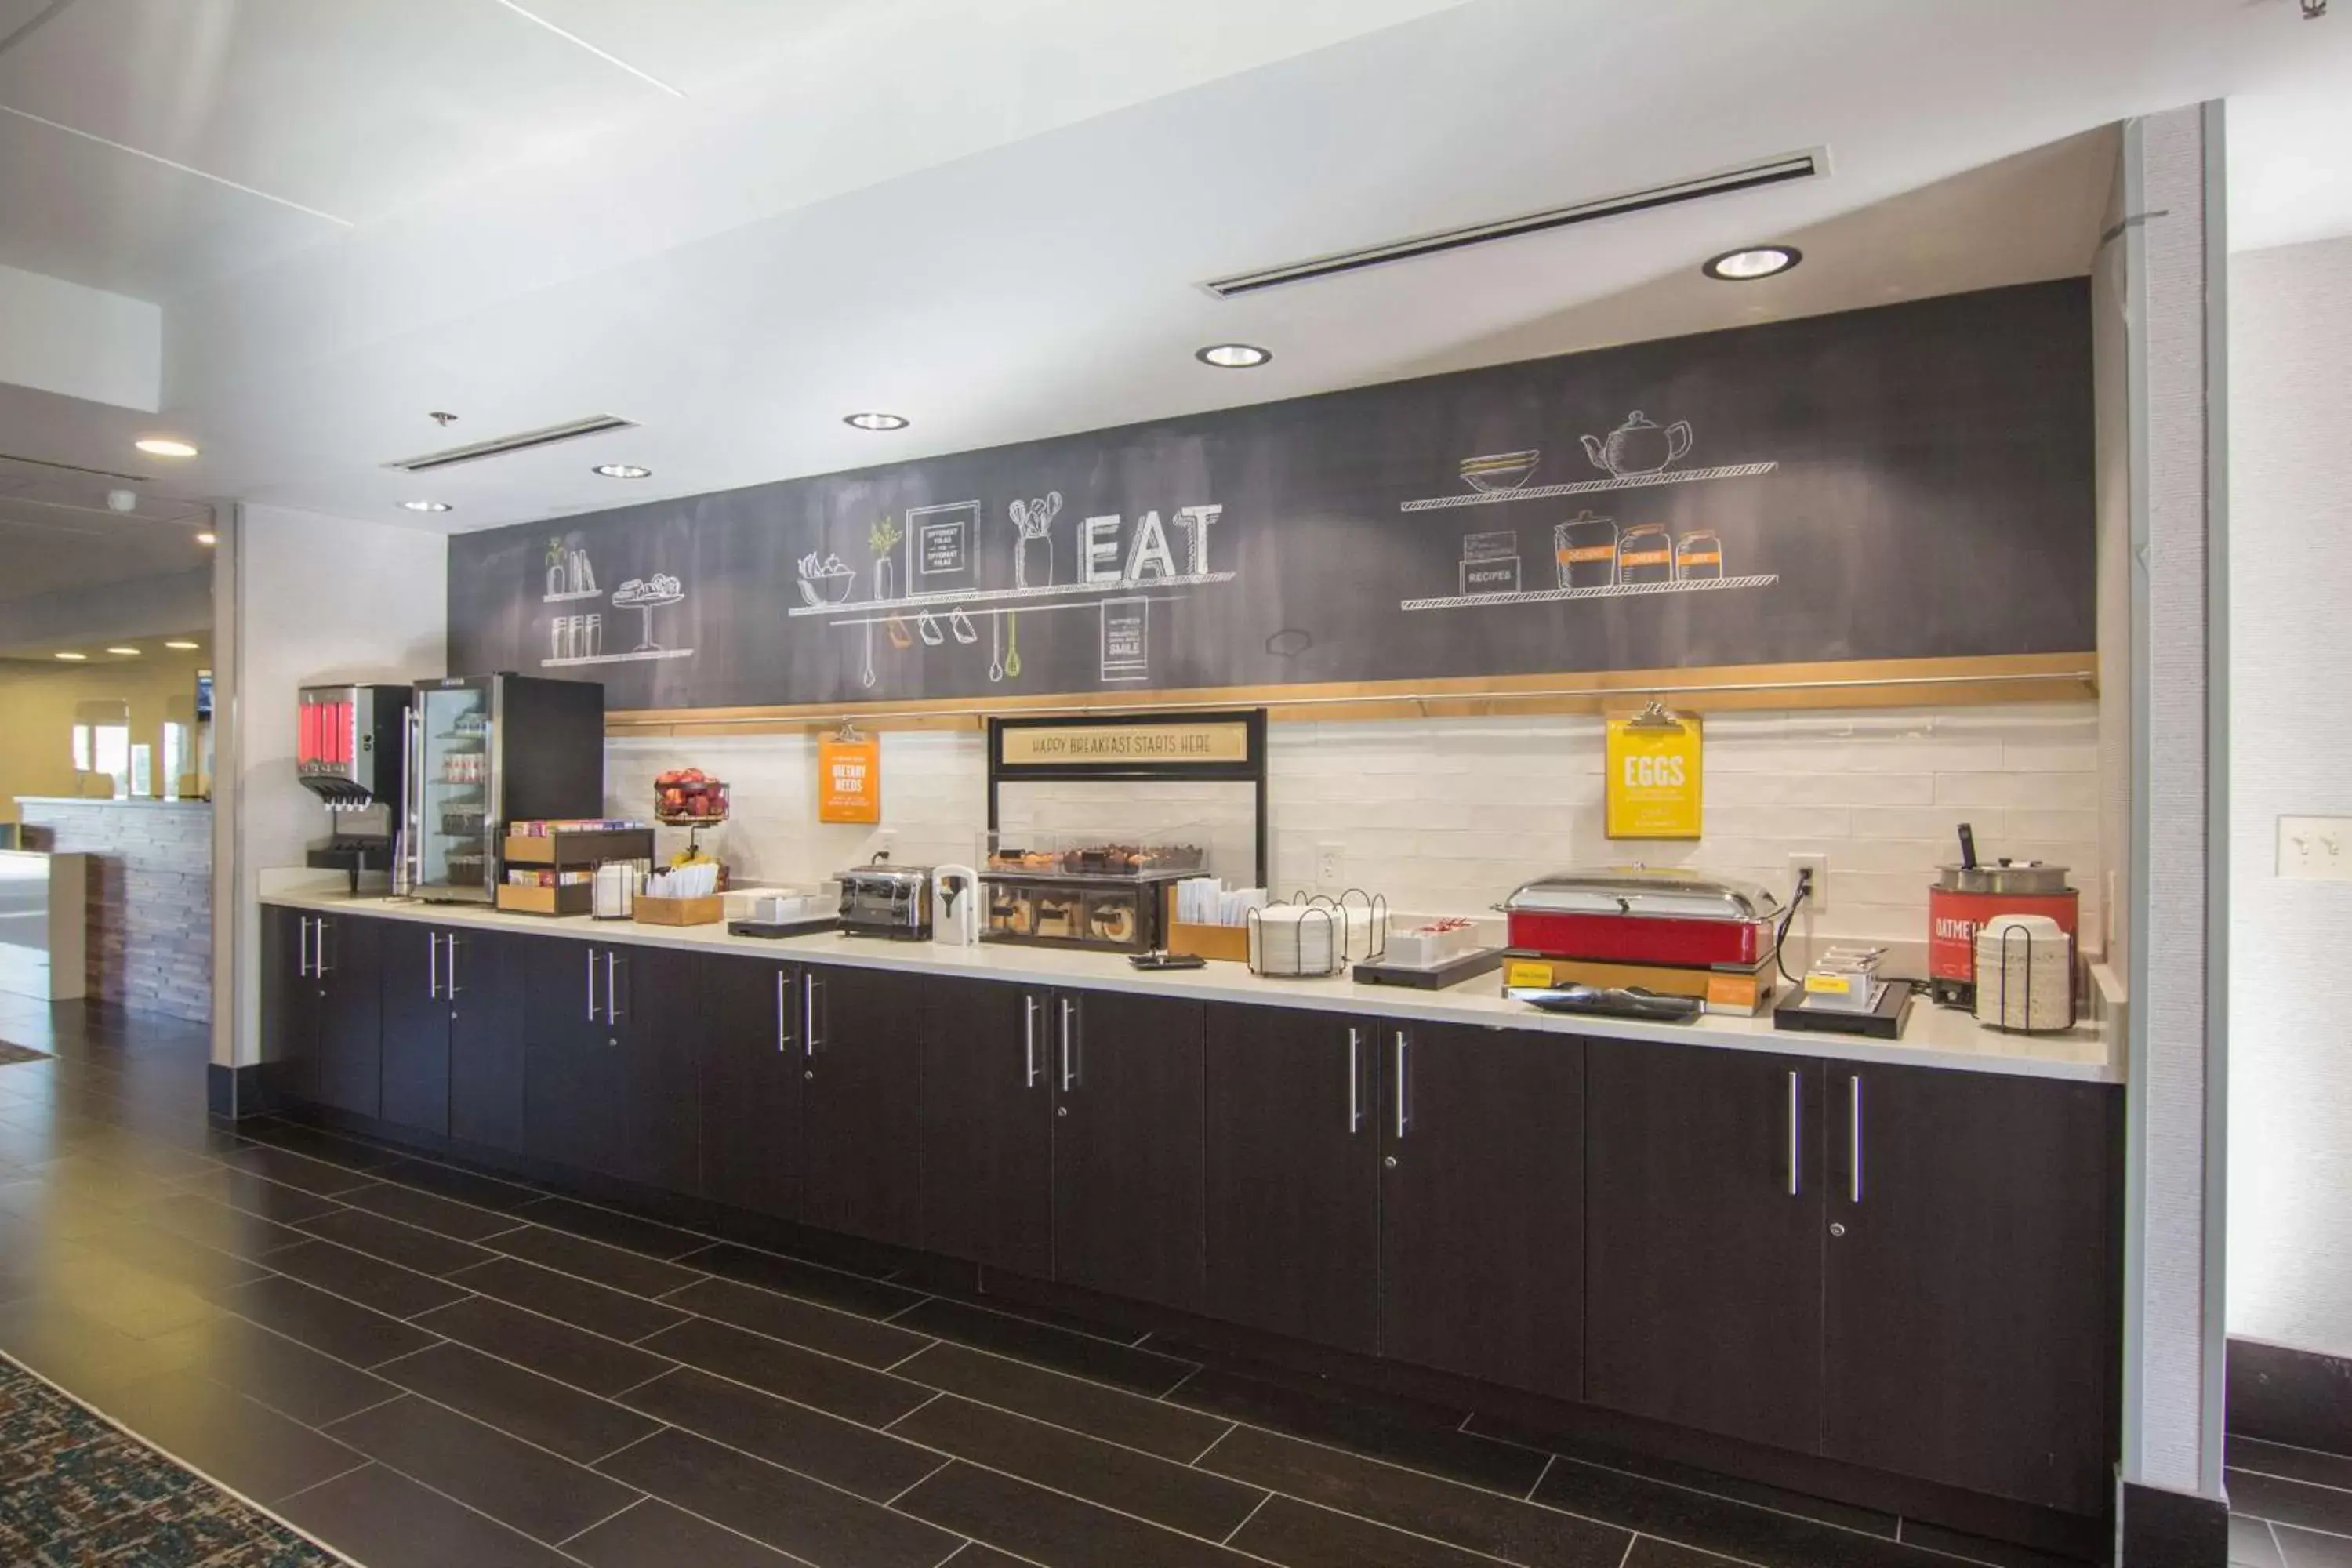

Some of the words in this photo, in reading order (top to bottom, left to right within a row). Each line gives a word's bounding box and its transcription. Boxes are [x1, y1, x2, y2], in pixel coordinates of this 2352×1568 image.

[1077, 504, 1223, 583] EAT
[1468, 570, 1512, 583] RECIPES
[1109, 643, 1141, 655] SMILE
[1033, 737, 1065, 753] HAPPY
[1070, 736, 1131, 753] BREAKFAST
[1134, 735, 1176, 753] STARTS
[1181, 734, 1210, 753] HERE
[1624, 754, 1686, 787] EGGS
[835, 779, 864, 793] NEEDS
